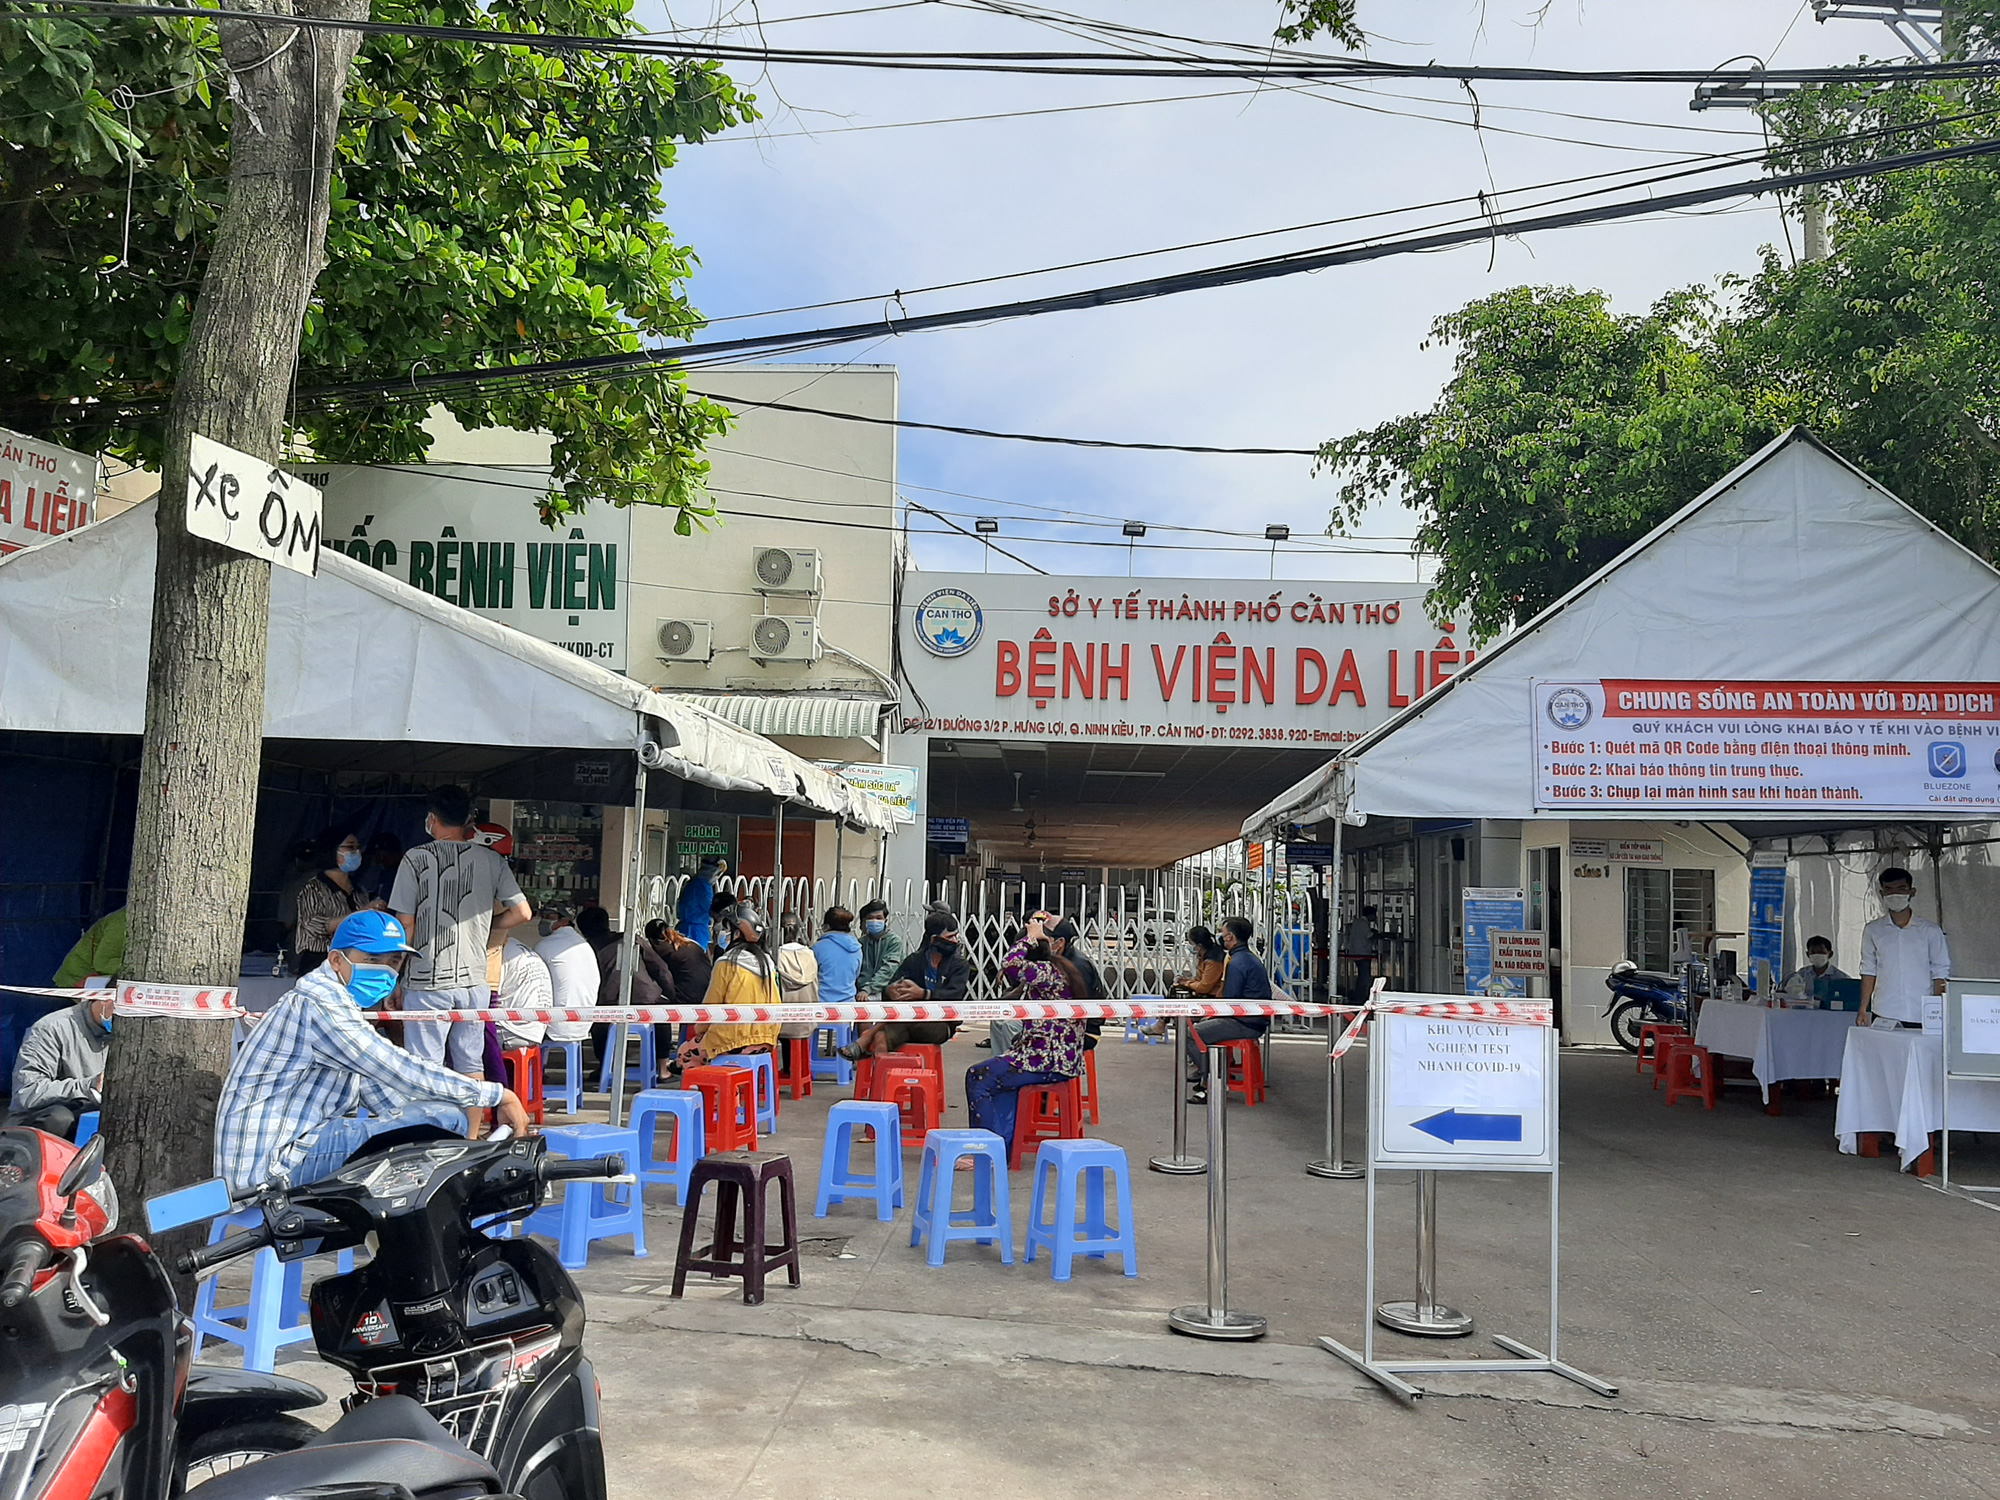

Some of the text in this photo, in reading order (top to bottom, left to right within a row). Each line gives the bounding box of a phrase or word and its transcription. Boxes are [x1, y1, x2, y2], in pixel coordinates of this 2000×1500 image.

[28, 452, 58, 474] THƠ
[303, 471, 329, 487] THƠ
[527, 528, 617, 626] VIỆN
[1048, 588, 1401, 624] SỞ Y TẾ THÀNH PHỐ CẦN THƠ
[996, 627, 1131, 708] BỆNH
[1150, 631, 1275, 713] VIỆN
[1296, 648, 1367, 707] DA
[1388, 622, 1476, 708] LIỄ
[1619, 686, 1994, 716] CHUNG SỐNG AN TOÀN VỚI ĐẠI DỊCH
[1632, 721, 1660, 734] QUÝ
[1665, 721, 1714, 734] KHÁCH
[1718, 724, 1741, 734] VUI
[1745, 722, 1782, 735] LÒNG
[1787, 724, 1820, 735] KHAI
[1825, 722, 1853, 735] BÁO
[1857, 724, 1866, 735] Y
[1869, 721, 1885, 735] TẾ
[1888, 725, 1910, 736] KHI
[1914, 722, 1944, 736] VÀO
[1949, 723, 1983, 739] BỆNH
[1552, 741, 1585, 755] Bước
[1589, 742, 1601, 754] 1:
[1605, 741, 1636, 755] Quét
[1639, 742, 1660, 755] mã
[1664, 742, 1682, 756] QR
[1687, 741, 1720, 755] Code
[1724, 739, 1757, 756] bằng
[1793, 741, 1828, 758] thoại
[1831, 742, 1869, 757] thông
[1873, 742, 1912, 756] minh.
[1552, 763, 1804, 779] Bước 2: Khai báo thông tin trung thực.
[1553, 785, 1586, 798] Bước
[1590, 785, 1602, 798] 3:
[1607, 785, 1640, 800] Chụp
[1732, 788, 1756, 799] sau
[1760, 785, 1780, 799] khi
[1784, 785, 1818, 799] hoàn
[1821, 786, 1863, 800] thành.
[1924, 783, 1971, 791] BLUEZONE
[685, 824, 720, 838] PHÒNG
[677, 840, 728, 854] THU NGÂN
[1427, 1022, 1511, 1037] KHU VỰC XÉT
[1427, 1042, 1511, 1056] NGHIỆM TEST
[1418, 1060, 1521, 1072] NHANH COVID-19
